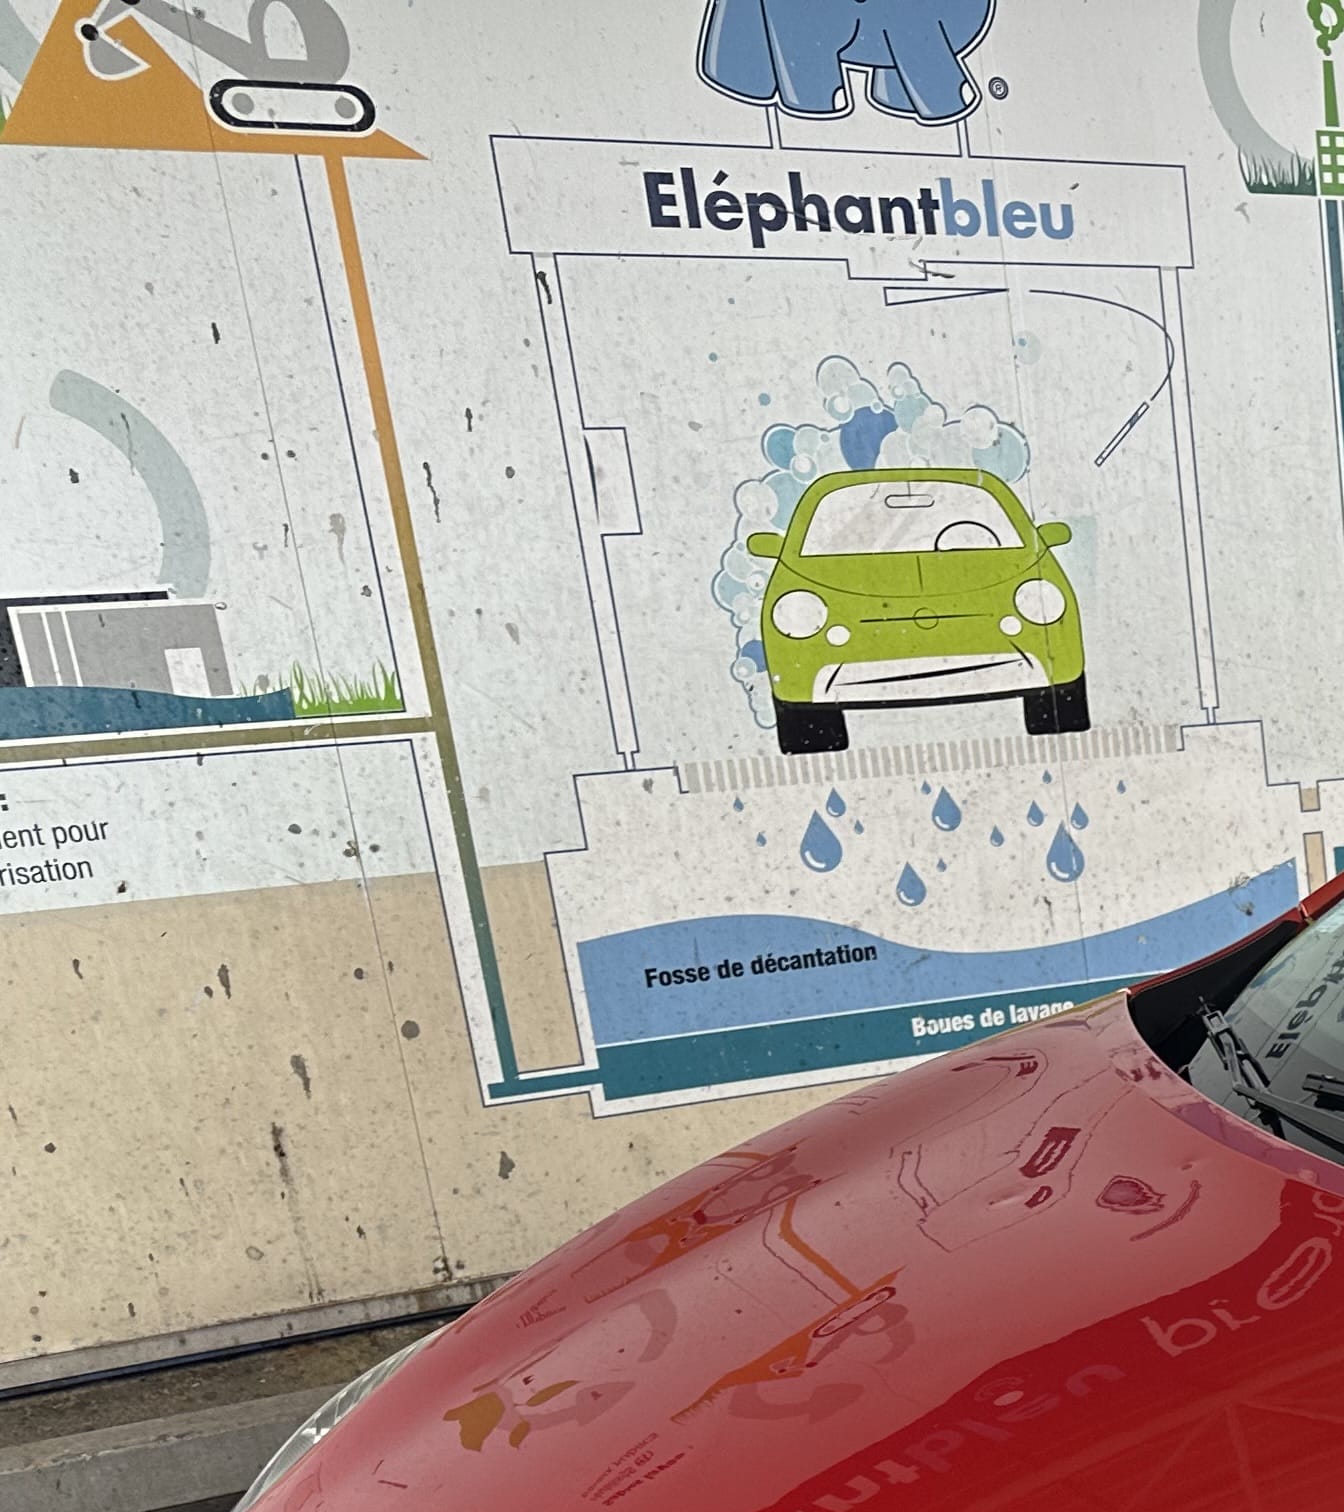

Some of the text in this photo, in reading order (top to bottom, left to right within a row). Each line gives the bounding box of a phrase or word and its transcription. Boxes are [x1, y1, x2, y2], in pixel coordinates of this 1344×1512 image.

[642, 168, 1075, 249] Eléphantbleu
[0, 820, 109, 850] ent pour
[644, 944, 878, 989] Fosse de décantation
[911, 1013, 975, 1038] Boues
[979, 1007, 1006, 1028] de
